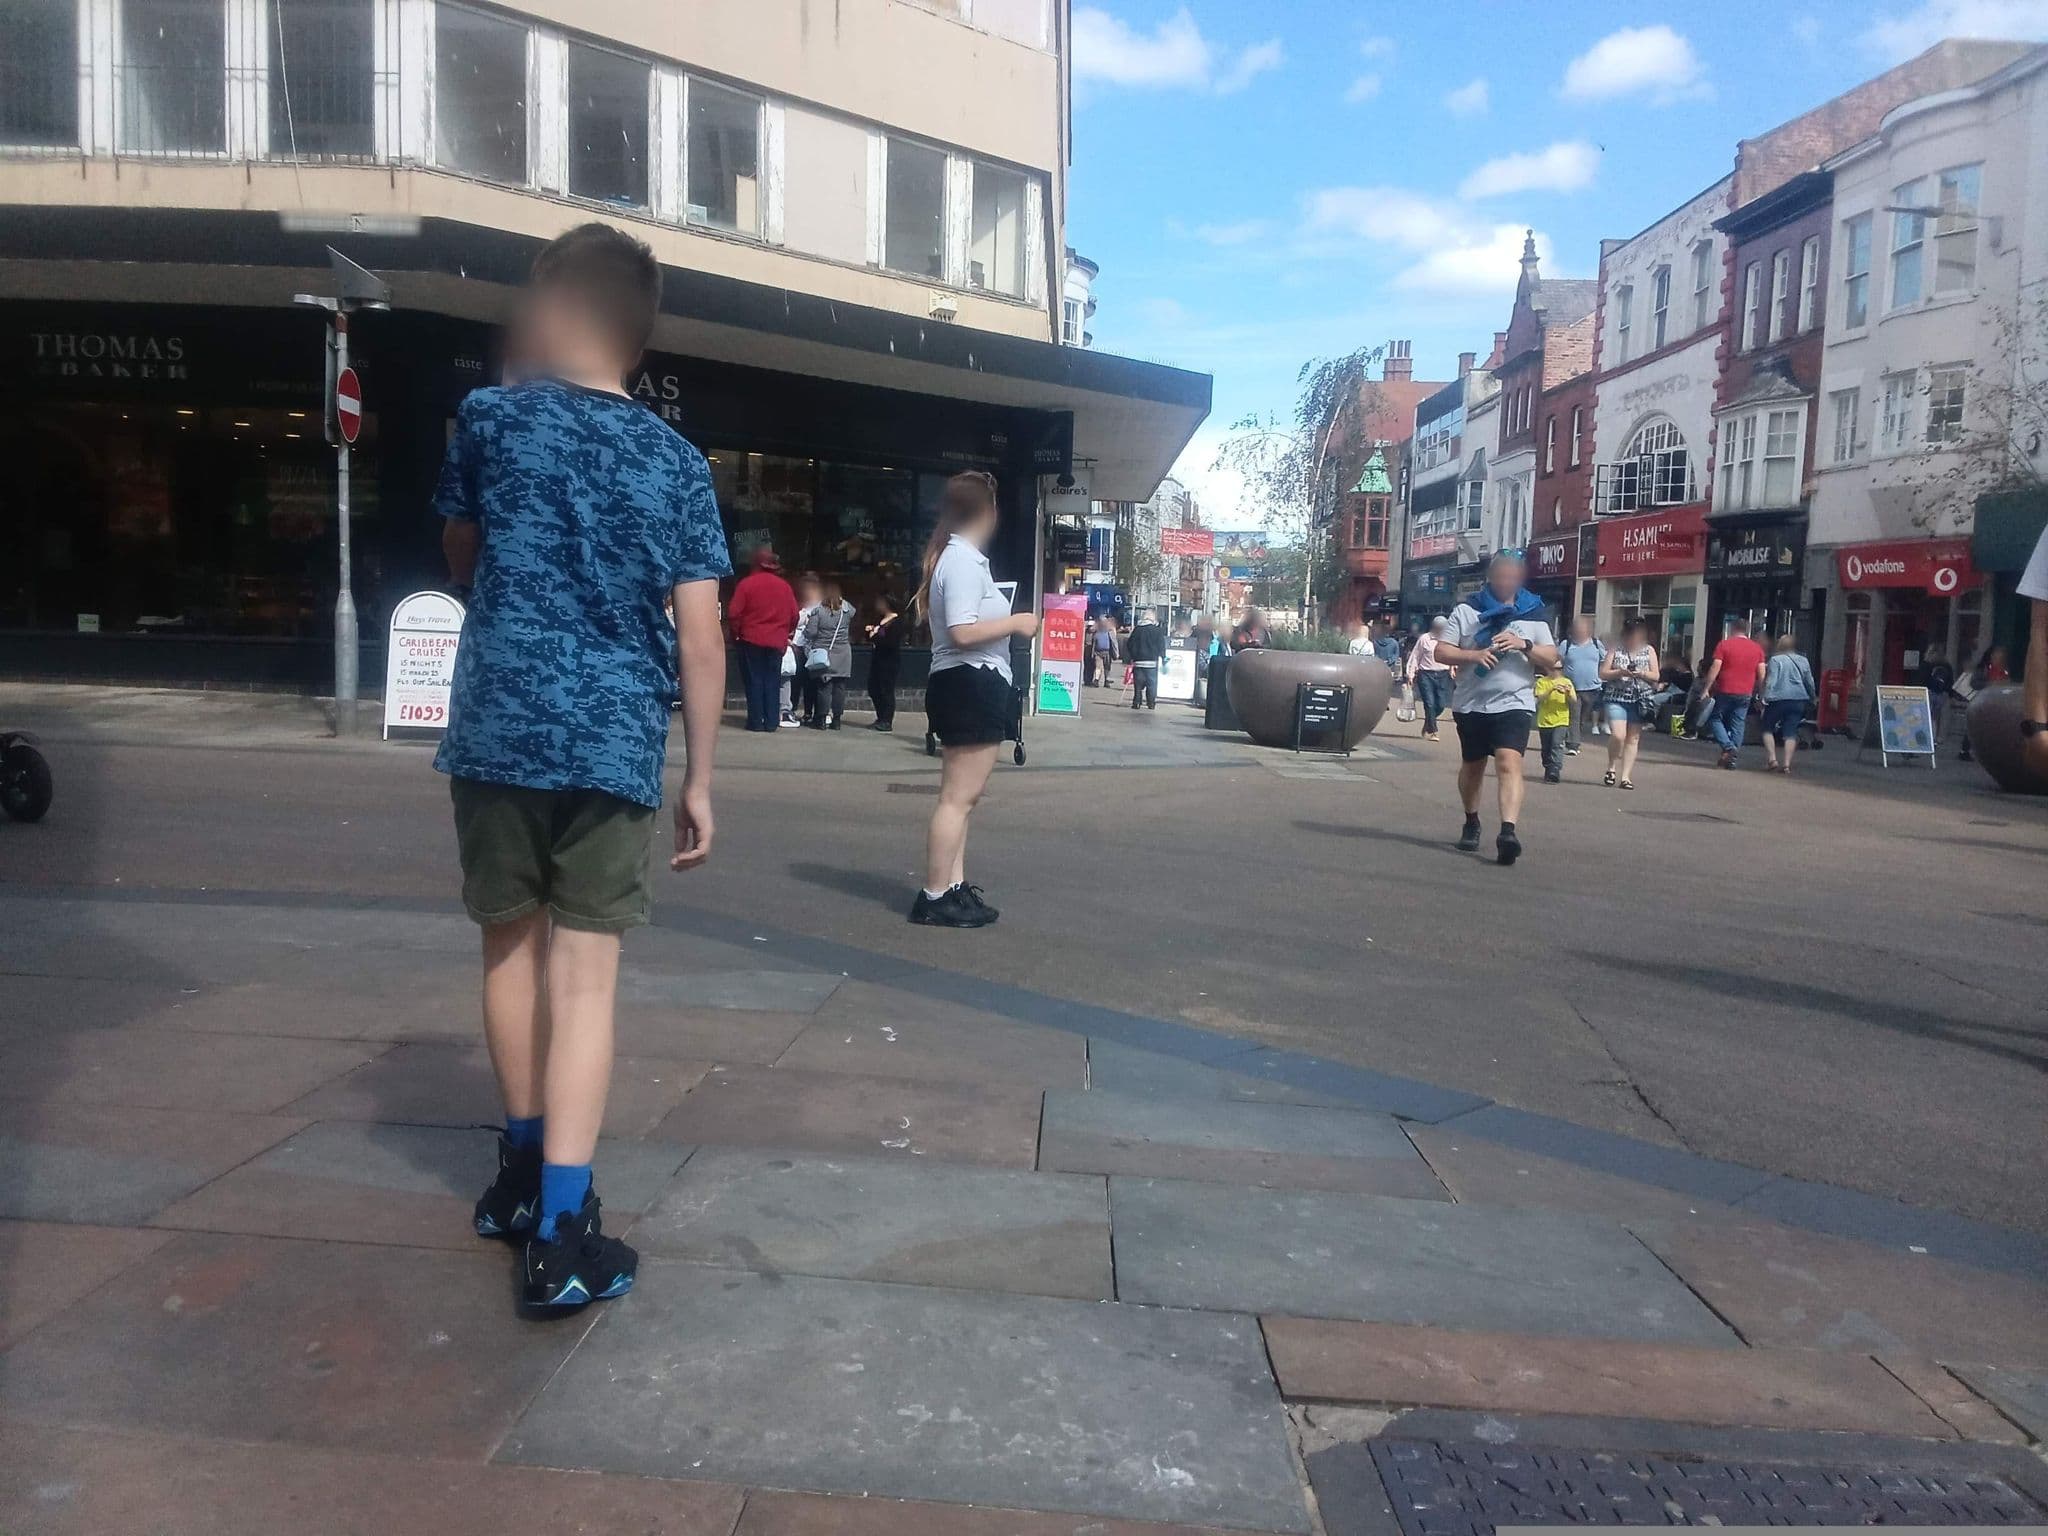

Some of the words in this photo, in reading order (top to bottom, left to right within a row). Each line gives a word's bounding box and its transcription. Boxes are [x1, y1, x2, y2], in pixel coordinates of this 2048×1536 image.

[31, 334, 184, 361] THOMAS
[61, 361, 187, 379] BAKER
[1051, 485, 1088, 496] claire's
[1539, 544, 1565, 568] TOKYO
[1728, 547, 1771, 566] MOBILISE
[1862, 559, 1905, 574] vodafone
[1049, 630, 1077, 639] SALE
[399, 637, 457, 648] CARIBBEAN
[409, 648, 446, 656] CRUISE
[1044, 670, 1062, 678] Free
[1044, 678, 1075, 688] Piercing
[400, 705, 444, 721] £1099
